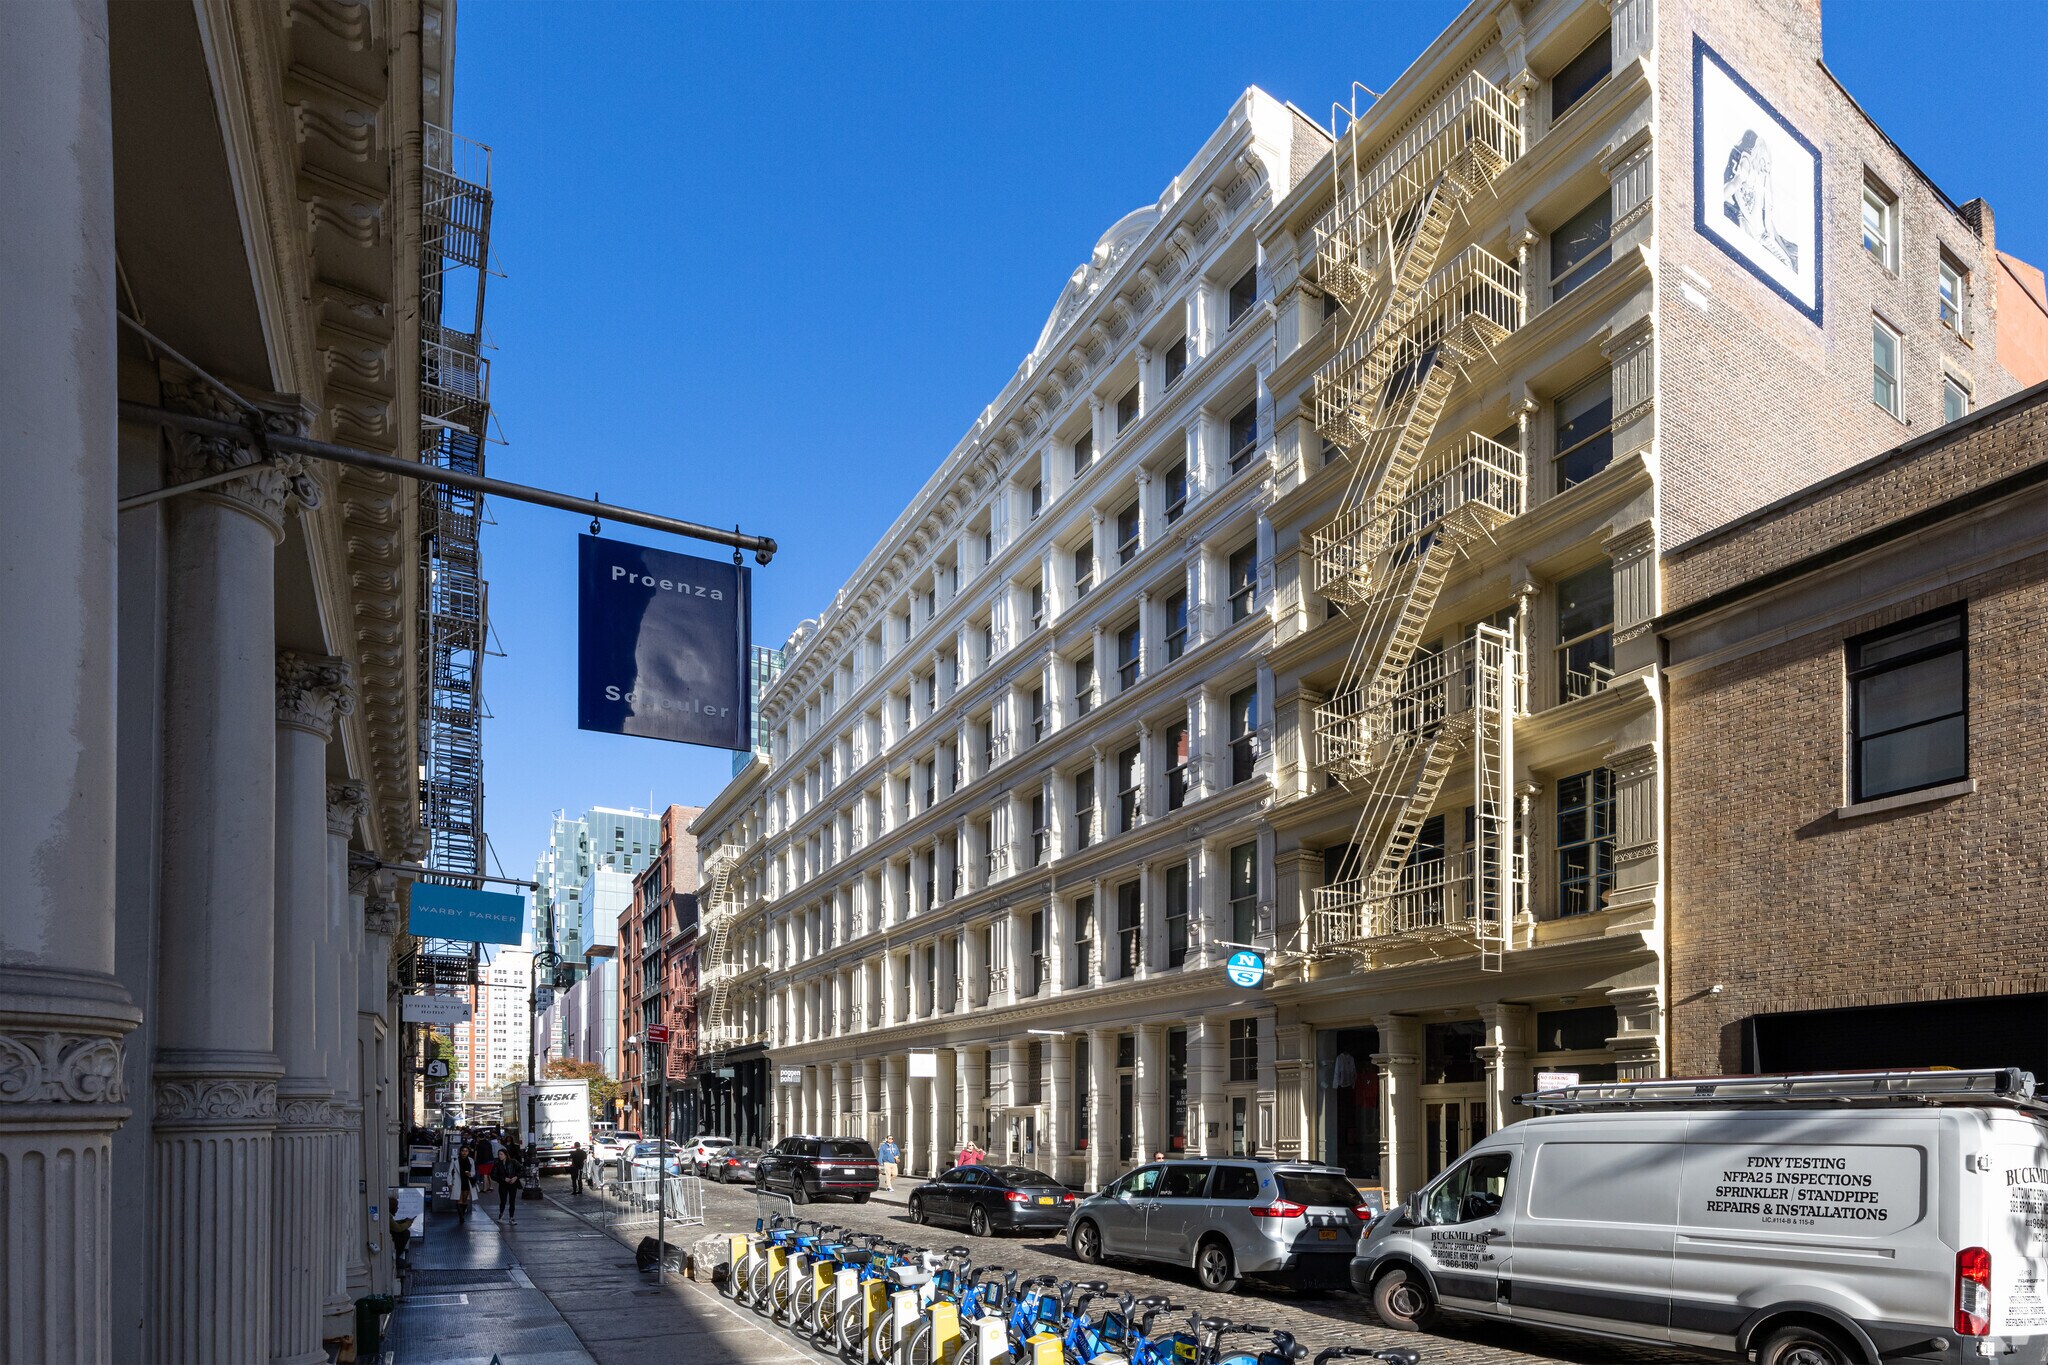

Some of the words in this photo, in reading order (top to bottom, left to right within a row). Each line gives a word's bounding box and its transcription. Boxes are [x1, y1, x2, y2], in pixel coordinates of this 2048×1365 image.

[611, 565, 723, 601] Proenza
[418, 905, 464, 916] WARBY
[469, 911, 517, 923] PARKER
[1237, 954, 1256, 966] N
[1237, 972, 1254, 983] S
[1747, 1156, 1783, 1168] FDNY
[1785, 1157, 1846, 1169] TESTING
[1723, 1171, 1773, 1183] NFPA25
[1776, 1173, 1872, 1187] INSPECTIONS
[1715, 1186, 1789, 1200] SPRINKLER
[1797, 1189, 1879, 1204] STANDPIPE
[1706, 1200, 1760, 1215] REPAIRS
[1763, 1203, 1773, 1215] &
[1775, 1204, 1888, 1221] INSTALLATIONS
[1431, 1231, 1490, 1245] BUCKMILLER
[1433, 1241, 1454, 1250] AUTOMATIC
[1454, 1242, 1475, 1252] SPRINKLER
[1475, 1244, 1487, 1253] CORP.
[1437, 1250, 1454, 1259] BROOME
[1445, 1260, 1479, 1270] 966-1980
